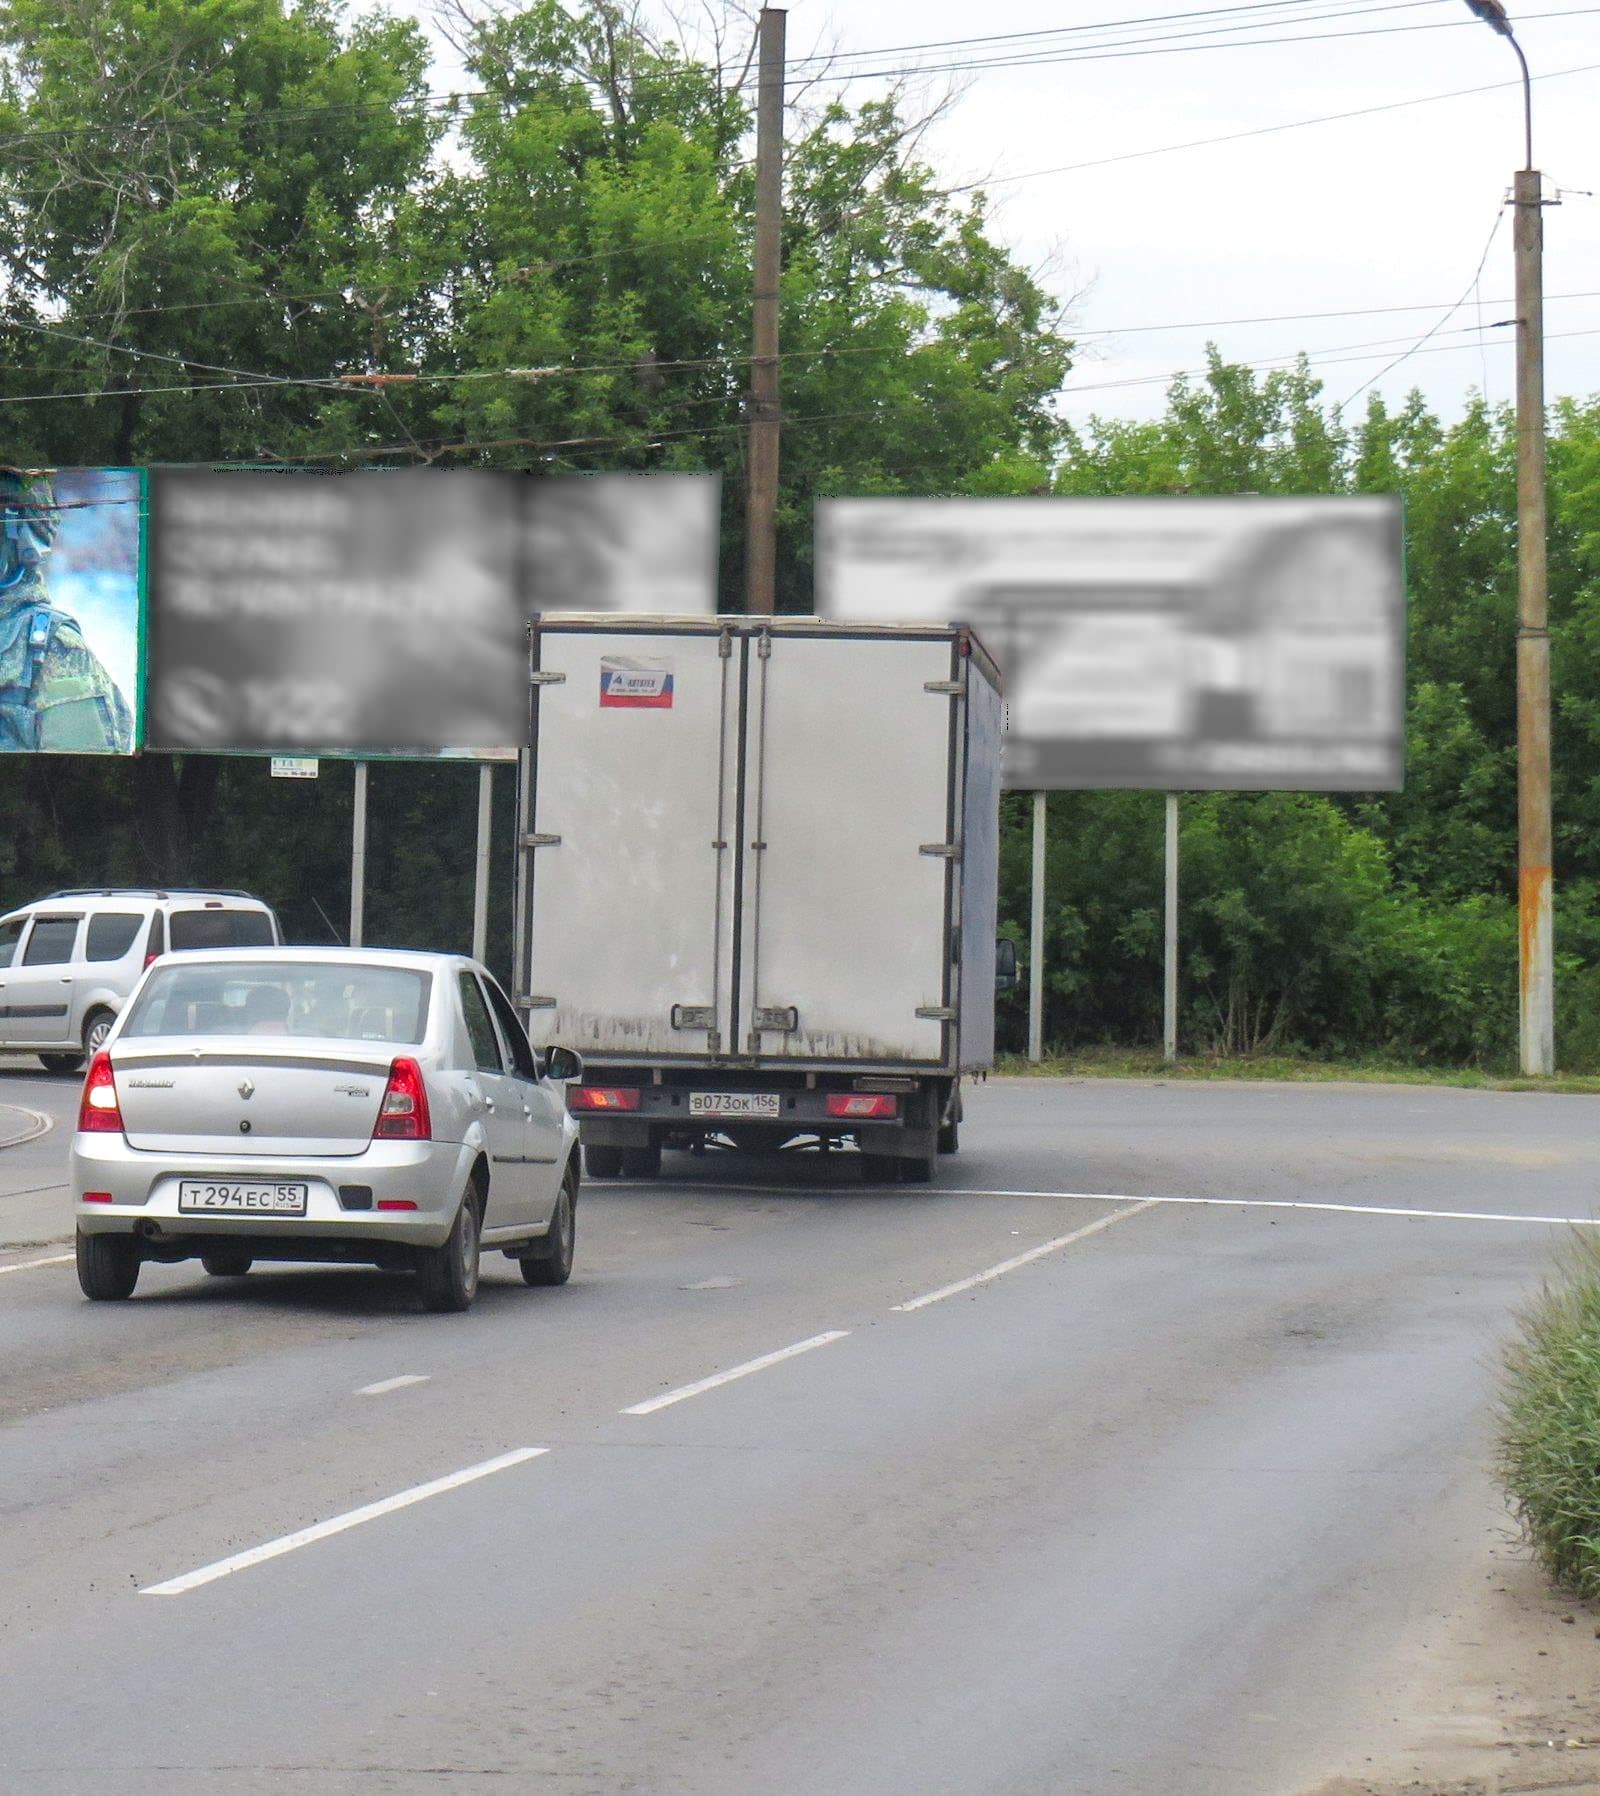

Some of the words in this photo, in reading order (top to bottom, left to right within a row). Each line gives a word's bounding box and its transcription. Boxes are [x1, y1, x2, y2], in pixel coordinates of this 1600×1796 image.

[754, 1095, 775, 1107] 156
[190, 1187, 270, 1206] Т294ЕС
[277, 1187, 297, 1202] 55
